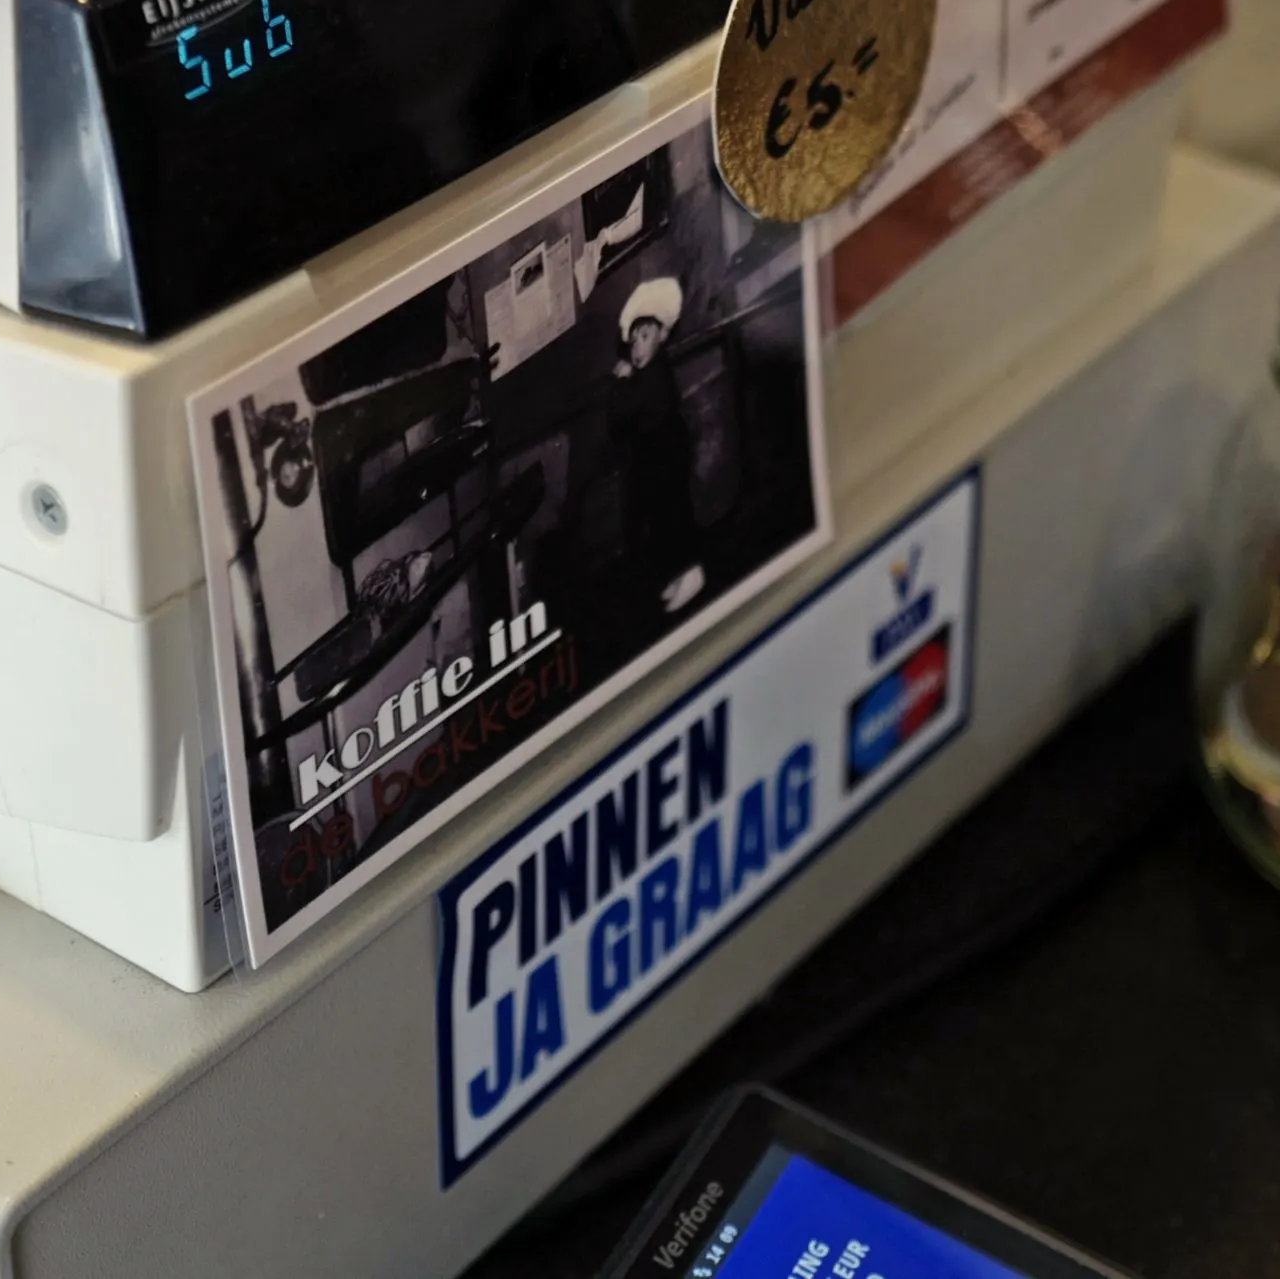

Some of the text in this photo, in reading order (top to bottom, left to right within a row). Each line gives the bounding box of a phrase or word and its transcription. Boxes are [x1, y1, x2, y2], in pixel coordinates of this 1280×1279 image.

[489, 600, 547, 669] in
[280, 803, 354, 887] de
[371, 636, 581, 814] bakkerij
[467, 695, 731, 1012] PINNEN
[467, 741, 816, 1121] JA GRAAG
[653, 1181, 725, 1270] Verifone
[832, 1239, 870, 1279] EUR
